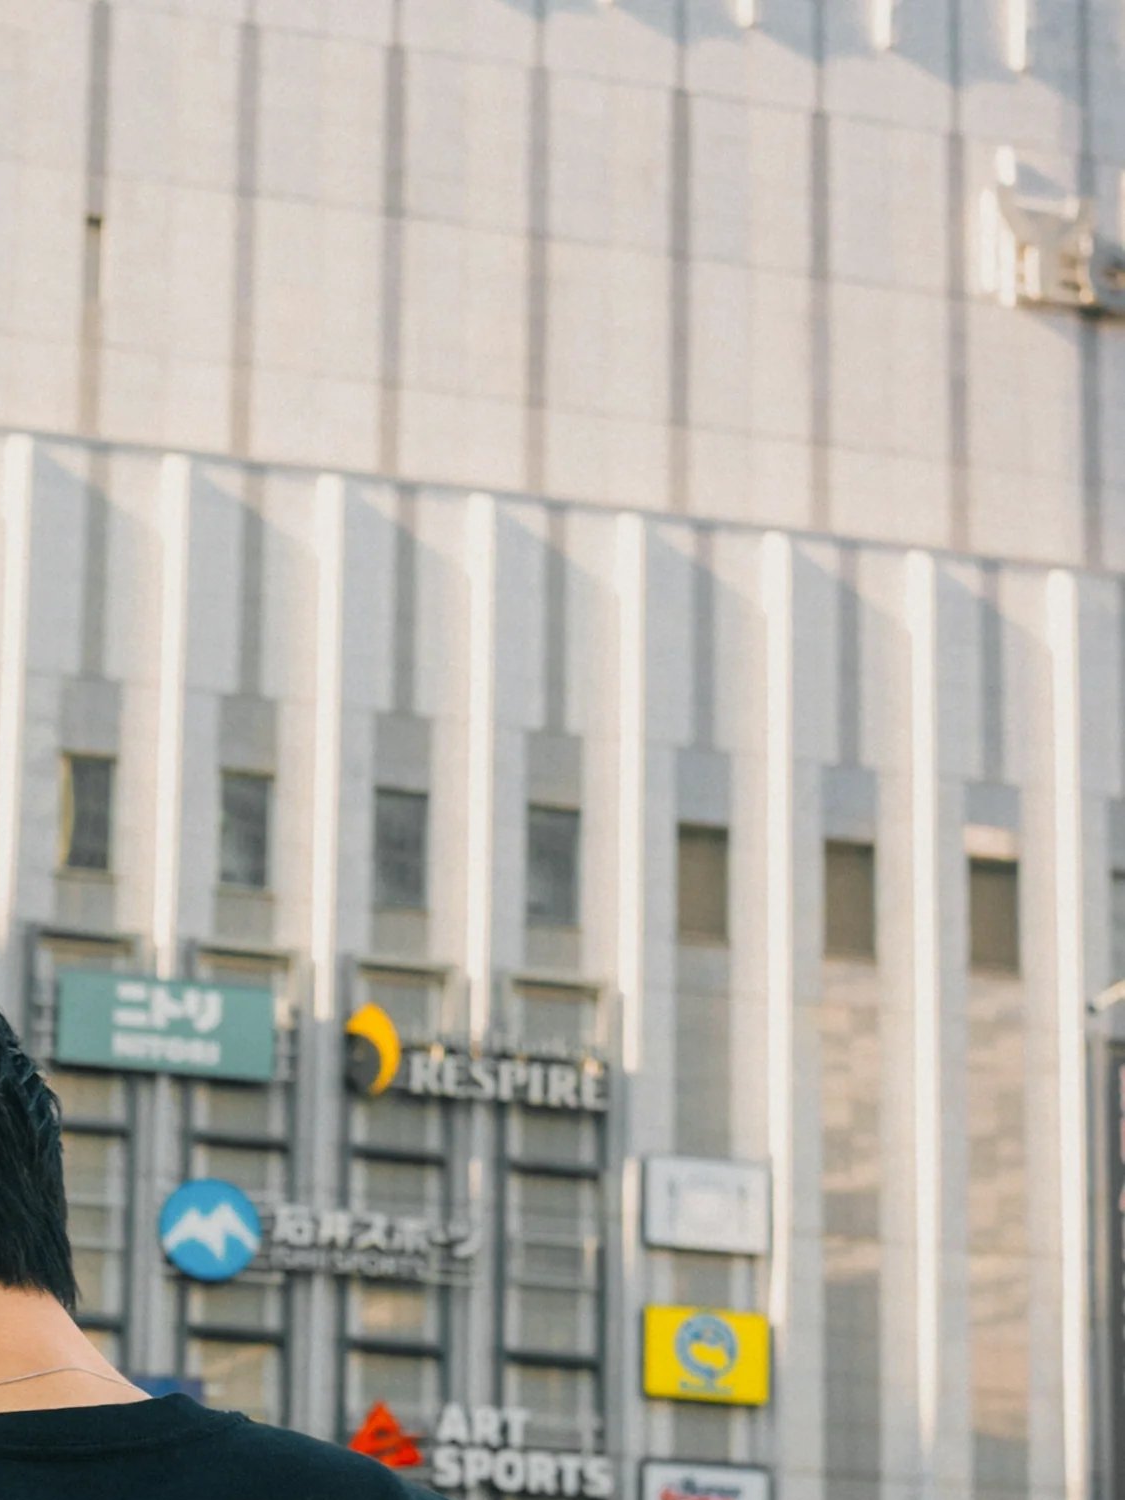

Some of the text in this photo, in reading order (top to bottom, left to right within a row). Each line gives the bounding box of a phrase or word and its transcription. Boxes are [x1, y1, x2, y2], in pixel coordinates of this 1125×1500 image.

[113, 982, 222, 1032] ニトリ
[409, 1052, 608, 1112] RESPIRE
[437, 1401, 530, 1448] ART
[432, 1446, 615, 1498] SPORTS
